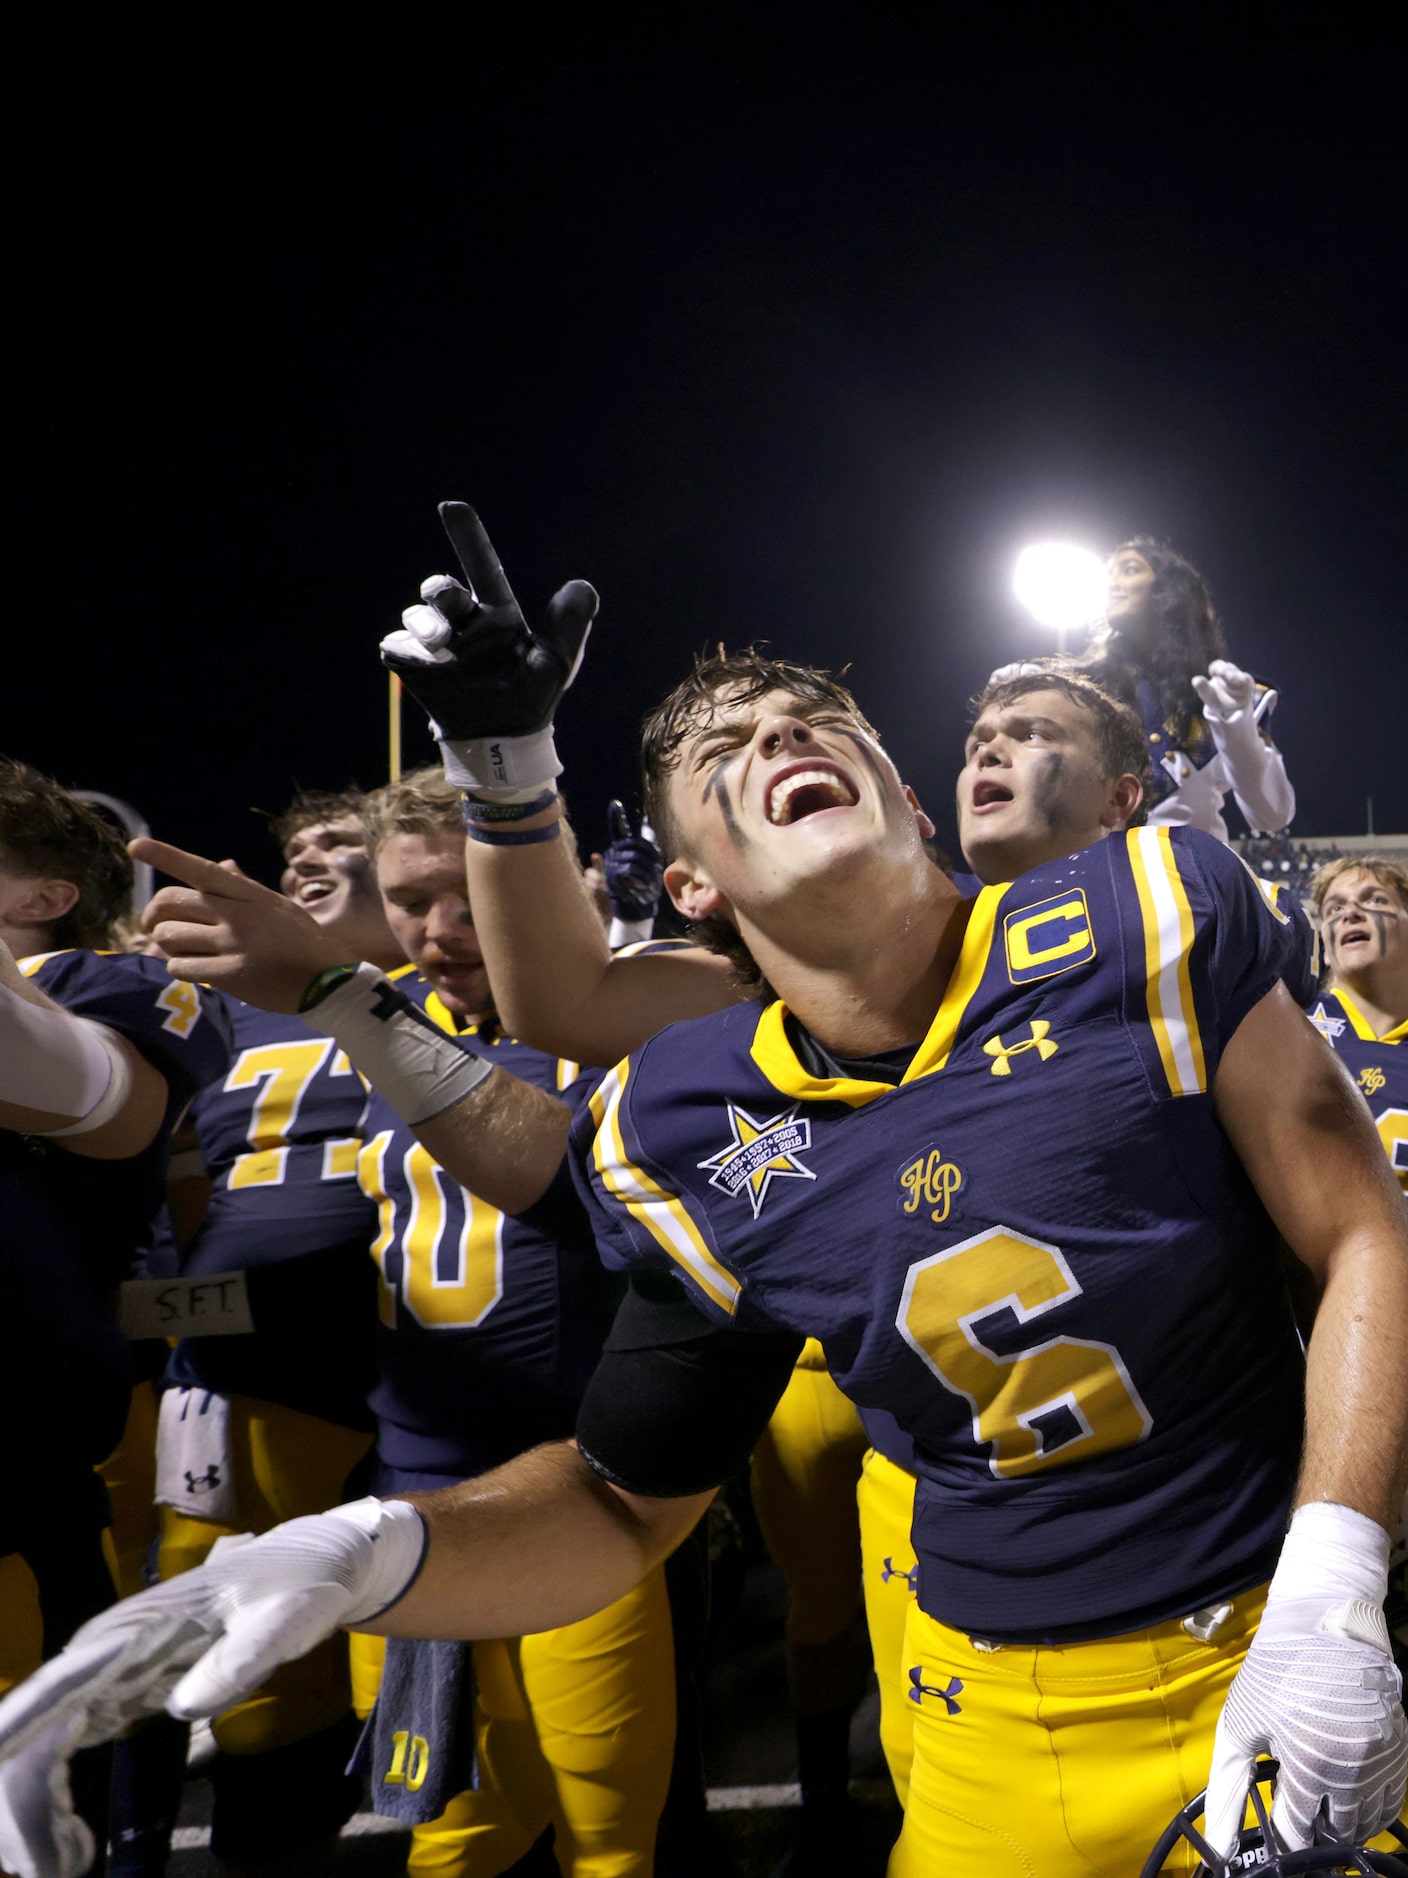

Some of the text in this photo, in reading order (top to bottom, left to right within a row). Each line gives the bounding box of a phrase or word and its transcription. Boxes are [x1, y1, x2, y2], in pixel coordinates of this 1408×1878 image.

[1007, 900, 1090, 971] C
[154, 978, 203, 1041] 4
[745, 1139, 768, 1159] 1957
[772, 1126, 798, 1142] 2005
[777, 1135, 803, 1152] 2018
[901, 1148, 963, 1222] HP
[895, 1224, 1154, 1479] 6
[384, 1730, 430, 1792] 10
